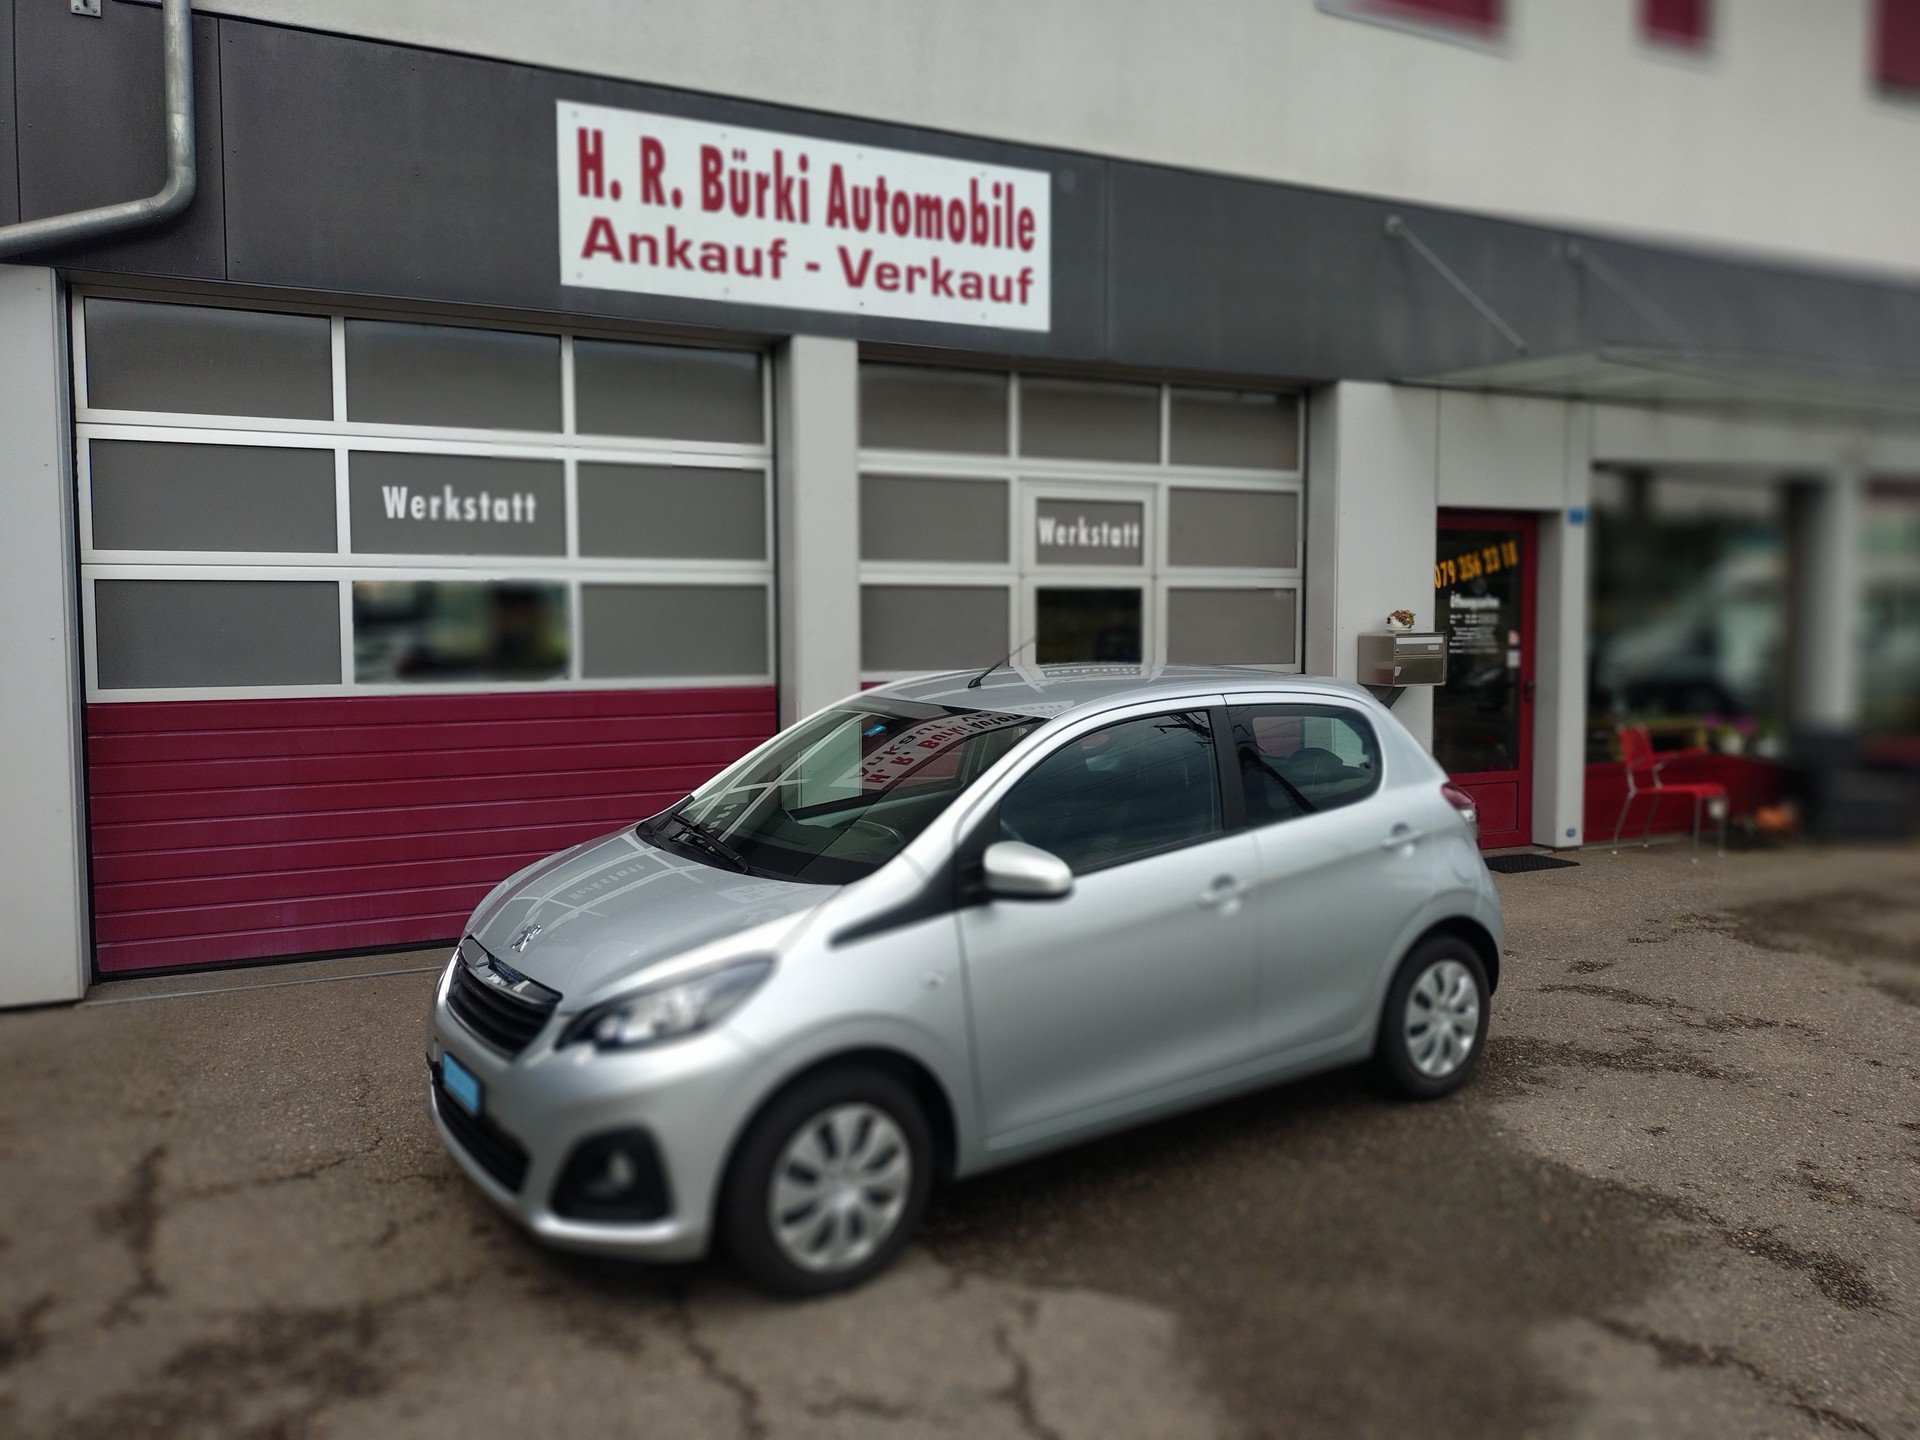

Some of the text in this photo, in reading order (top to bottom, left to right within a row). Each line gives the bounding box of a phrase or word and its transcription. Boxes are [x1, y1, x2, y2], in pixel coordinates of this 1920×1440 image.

[576, 127, 1036, 252] H. R. Bürki Automobile
[580, 216, 788, 280] Ankauf
[837, 245, 1036, 305] Verkauf
[381, 484, 537, 524] Werkstatt
[1037, 516, 1141, 549] Werkstatt
